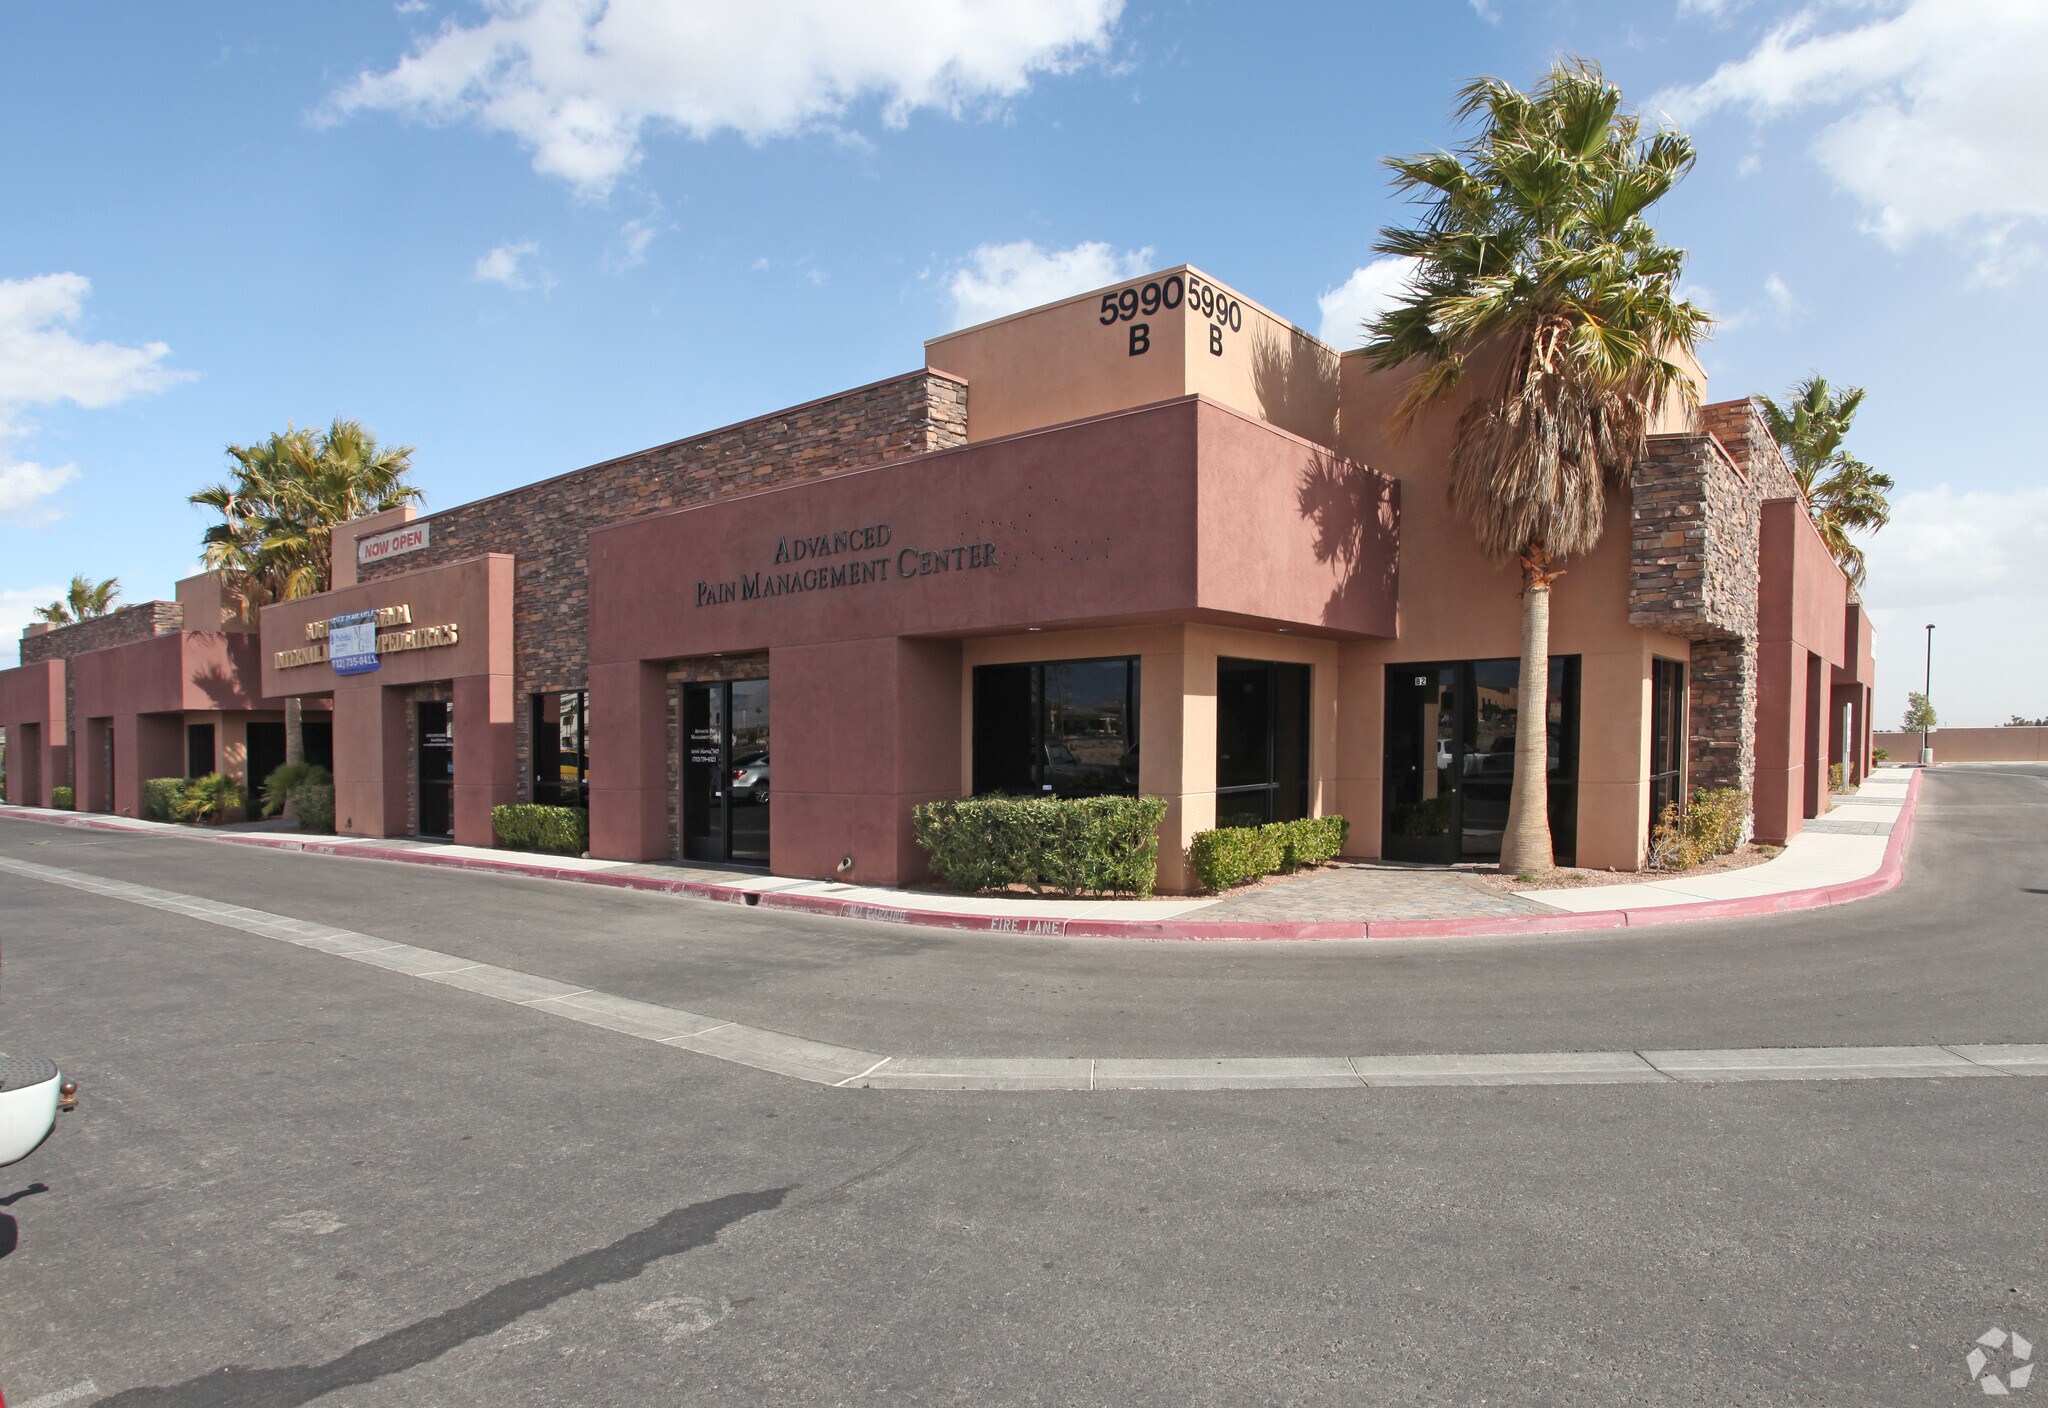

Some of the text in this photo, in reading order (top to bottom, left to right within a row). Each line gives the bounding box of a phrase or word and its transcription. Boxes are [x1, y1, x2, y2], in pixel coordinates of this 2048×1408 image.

[1099, 276, 1184, 325] 5990
[1188, 277, 1241, 332] 5990
[1129, 323, 1150, 356] B
[1210, 323, 1223, 357] B
[365, 531, 422, 558] NOW OPEN
[773, 524, 892, 564] ADVANCED
[696, 542, 998, 607] PAIN MANAGEMENT CENTER
[990, 918, 1061, 935] FIRE LANE
